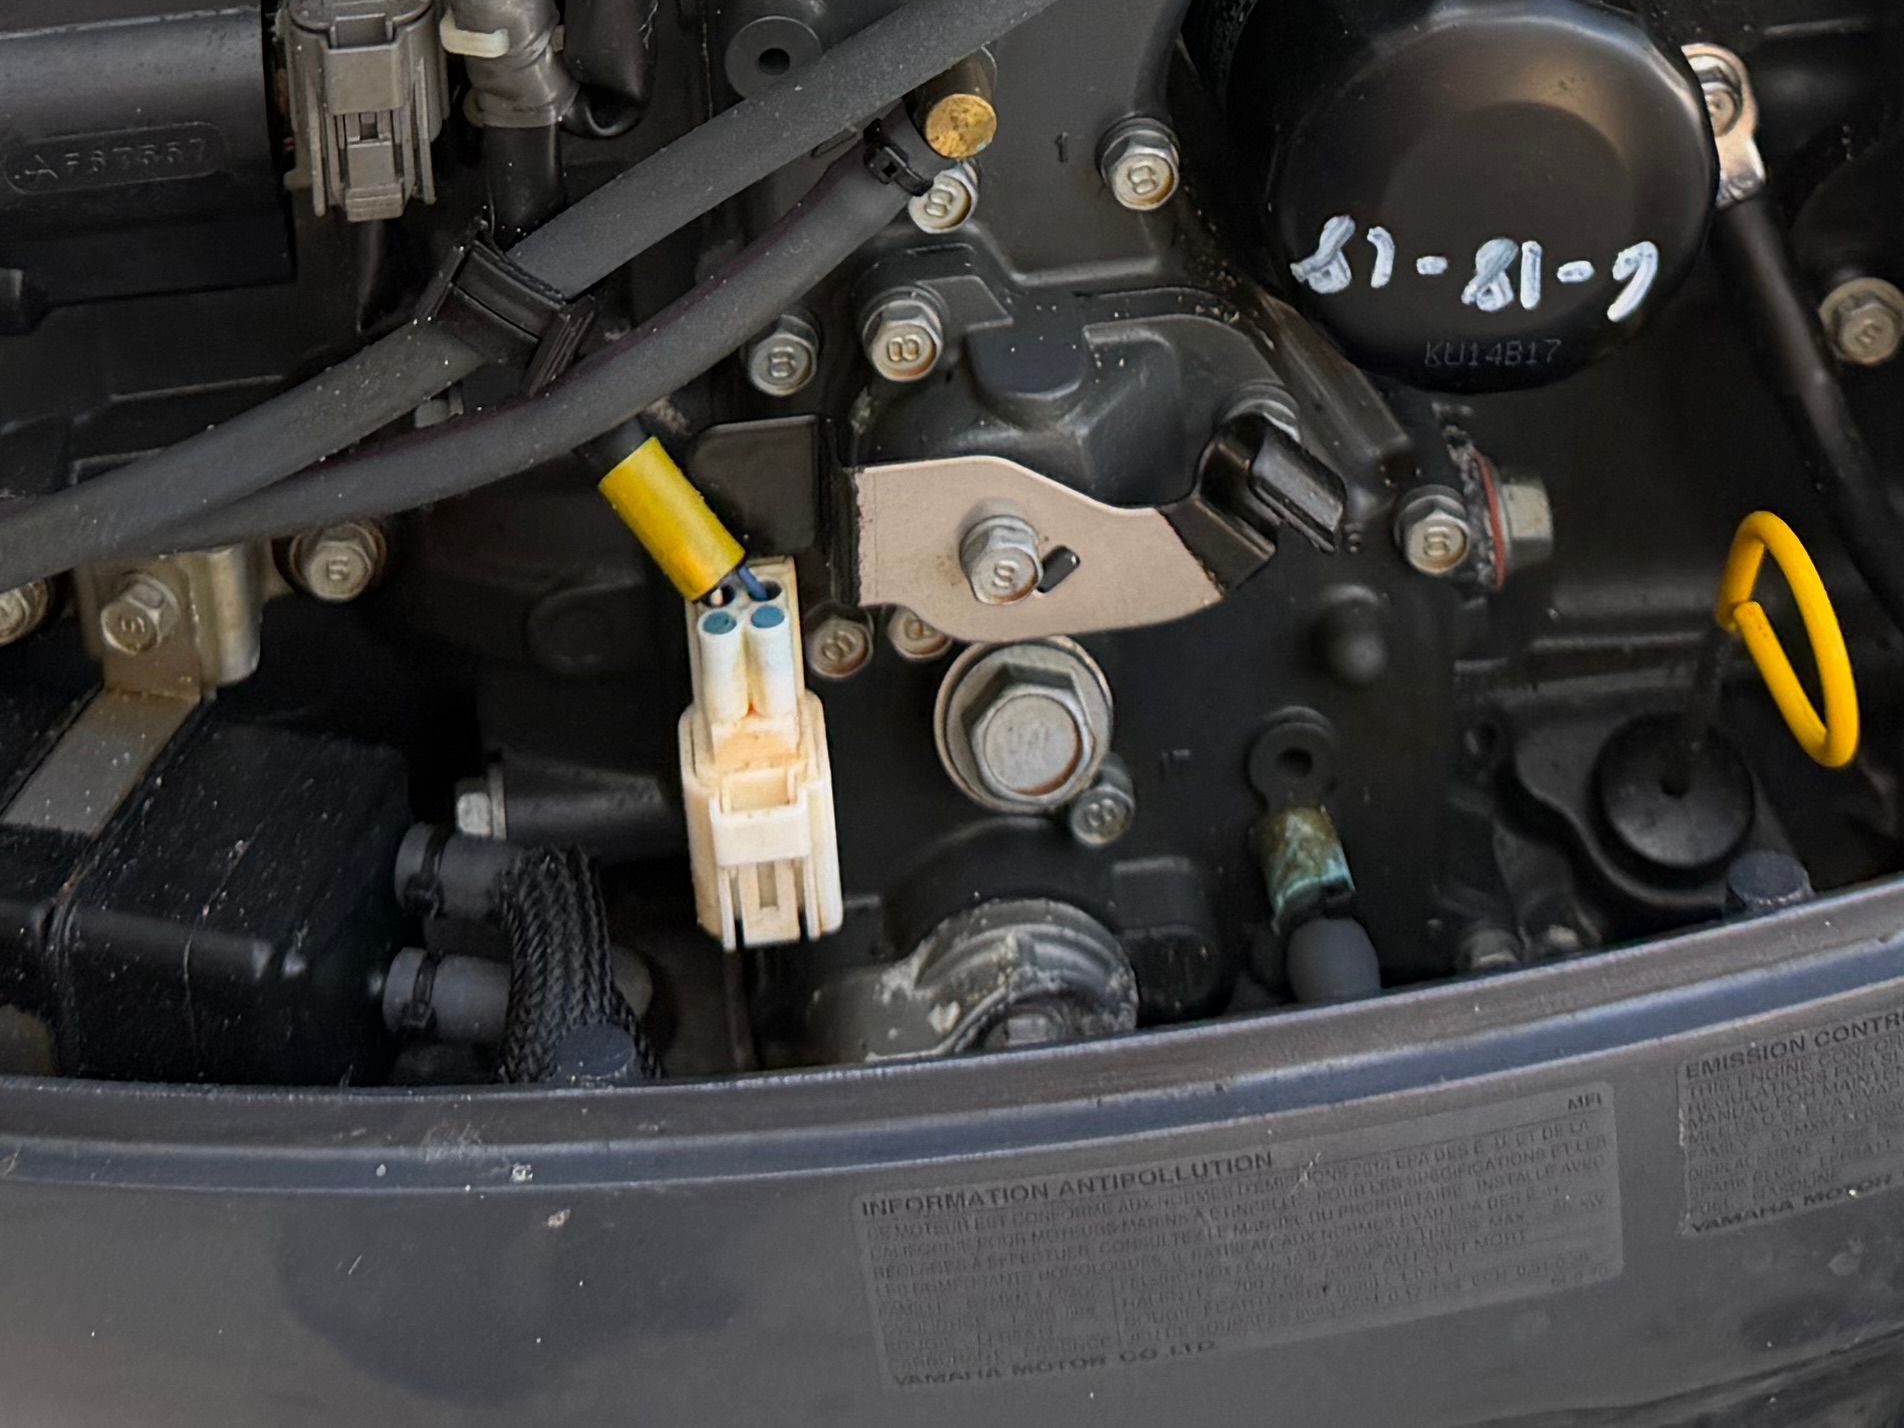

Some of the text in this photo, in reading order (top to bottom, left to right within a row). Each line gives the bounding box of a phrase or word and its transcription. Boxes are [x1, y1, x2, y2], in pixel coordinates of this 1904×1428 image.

[1685, 1034, 1806, 1081] EMISSION
[1567, 1090, 1602, 1111] MFI
[1394, 1149, 1430, 1170] EPA
[860, 1150, 1273, 1218] INFORMATION ANTIPOLLUTION
[1689, 1198, 1795, 1234] YAMAHA
[1802, 1172, 1892, 1204] MOTOR
[892, 1364, 1001, 1388] YAMAHA
[1010, 1353, 1106, 1376] MOTOR
